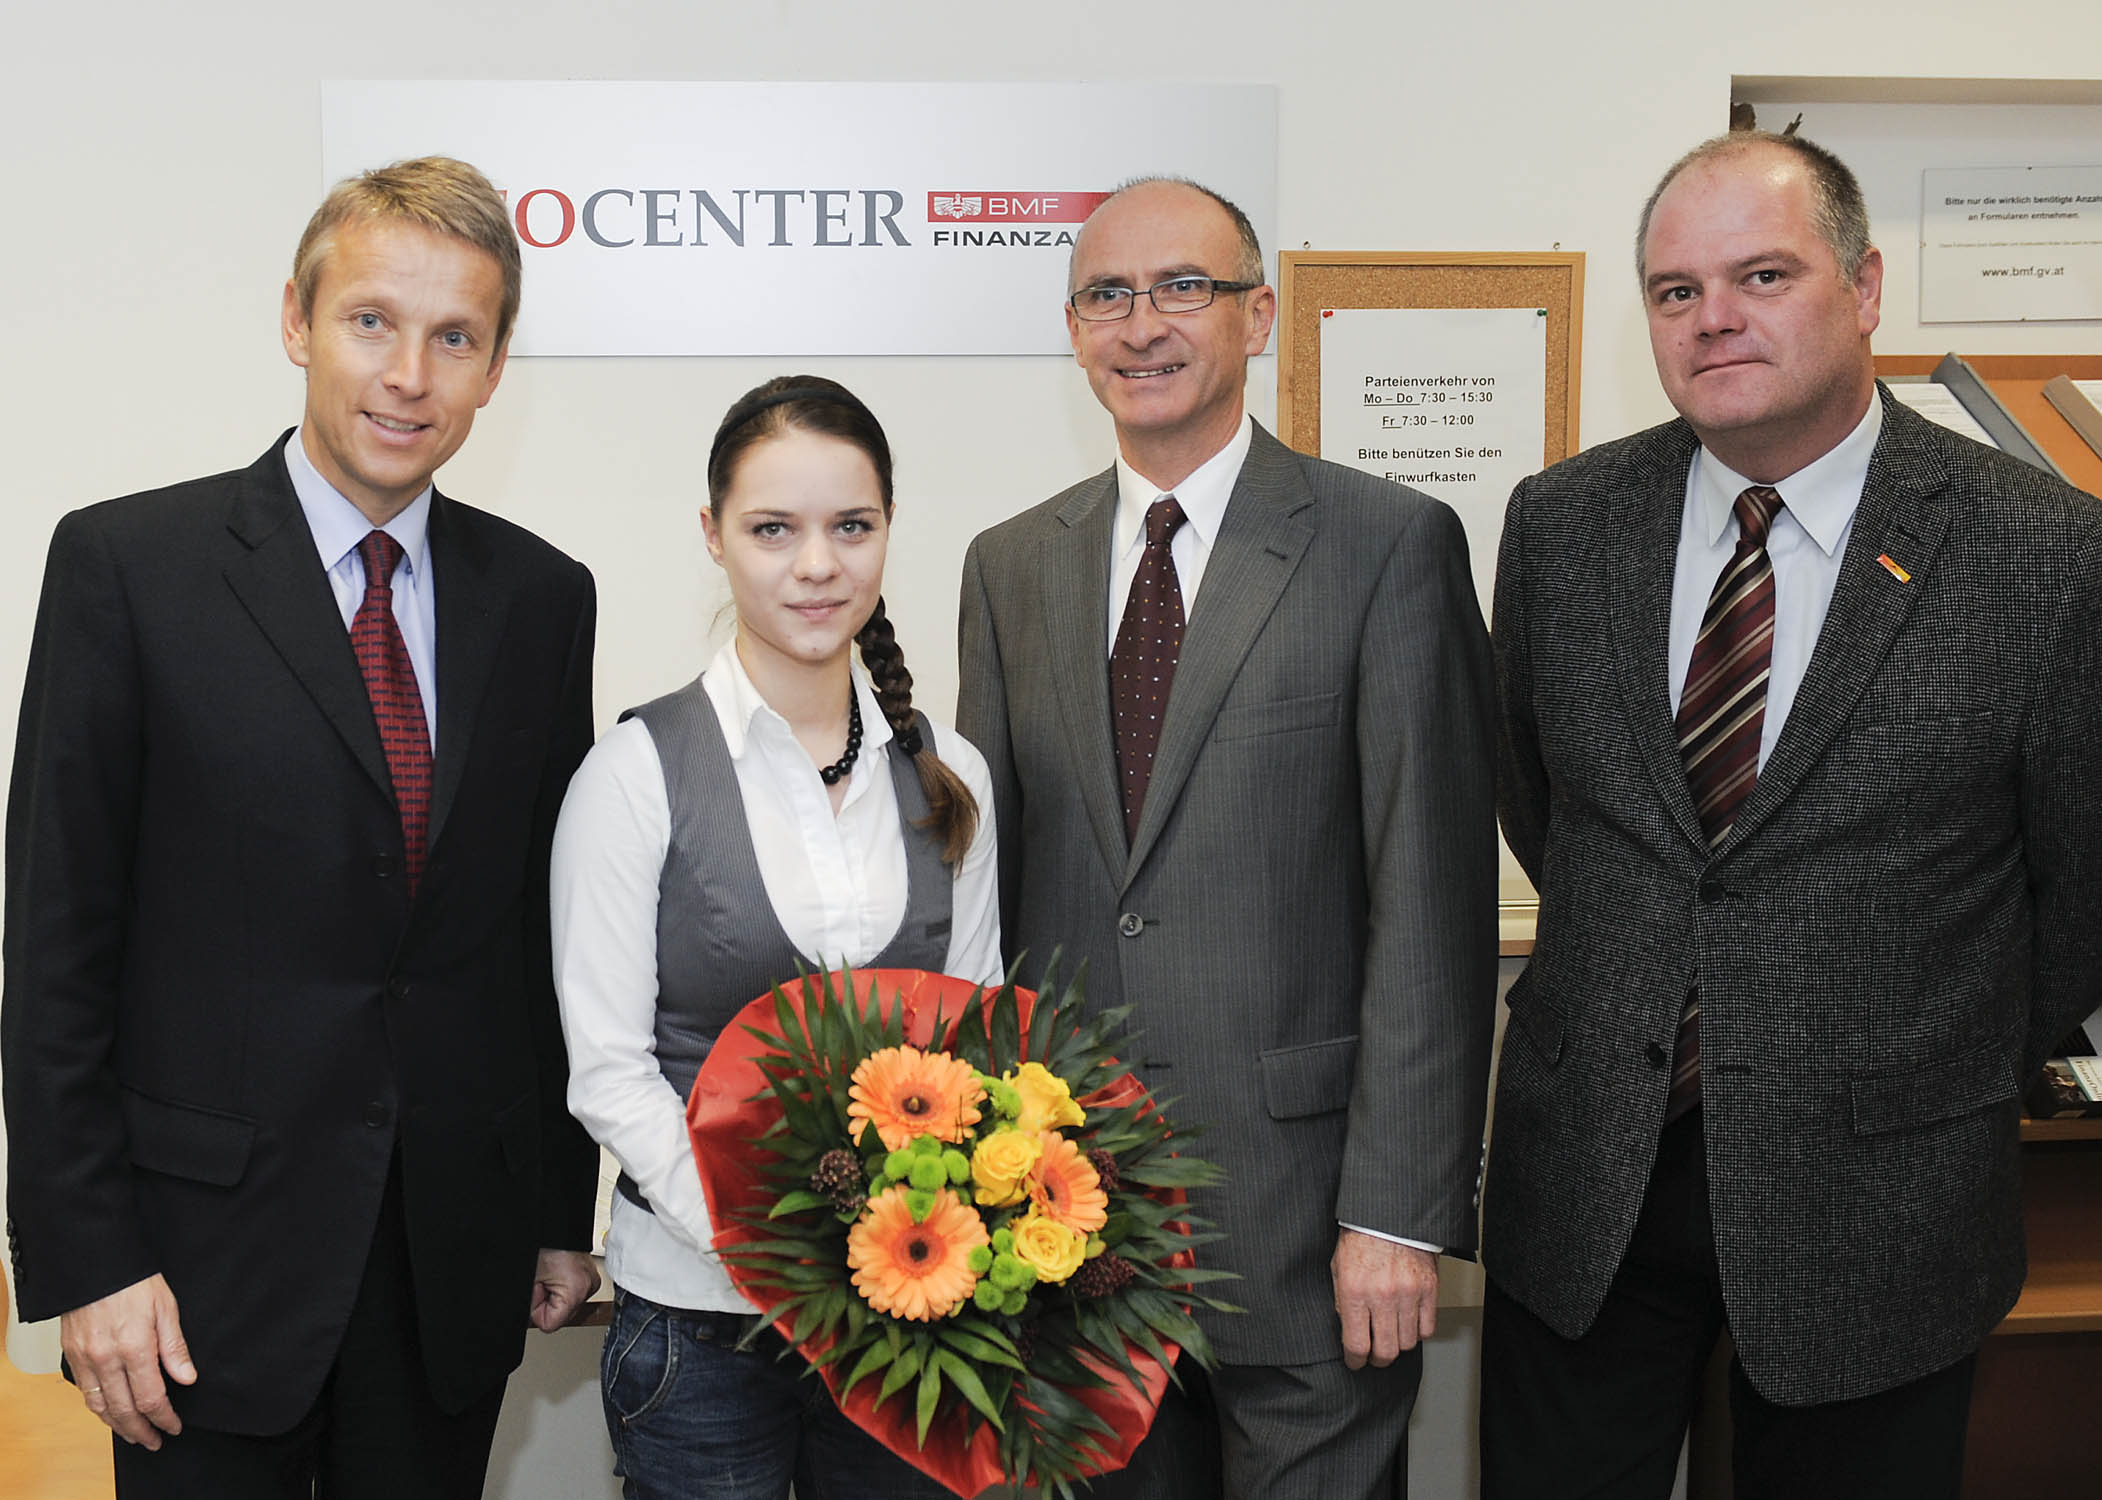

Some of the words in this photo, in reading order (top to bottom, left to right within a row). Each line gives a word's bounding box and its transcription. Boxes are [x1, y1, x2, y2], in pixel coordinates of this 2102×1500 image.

[1944, 197, 1965, 206] Bitte
[1967, 198, 1981, 206] nur
[1984, 196, 1997, 205] die
[1999, 196, 2031, 205] wirklich
[2033, 195, 2073, 206] benötigte
[988, 198, 1060, 216] BMF
[496, 189, 911, 248] OCENTER
[1968, 214, 1978, 222] an
[1981, 212, 2029, 221] Formularen
[1982, 266, 2065, 279] www.bmf.gv.at
[1365, 376, 1468, 388] Parteienverkehr
[1472, 378, 1495, 387] von
[1364, 393, 1382, 404] Mo
[1397, 393, 1413, 404] Do
[1420, 392, 1446, 403] 7:30
[1461, 392, 1493, 403] 15:30
[1382, 416, 1395, 426] Fr
[1401, 416, 1427, 426] 7:30
[1442, 415, 1474, 426] 12:00
[1358, 448, 1388, 460] Bitte
[1393, 448, 1451, 459] benützen
[1455, 447, 1474, 459] Sie
[1479, 447, 1502, 458] den
[1385, 471, 1477, 483] Einwurfkasten
